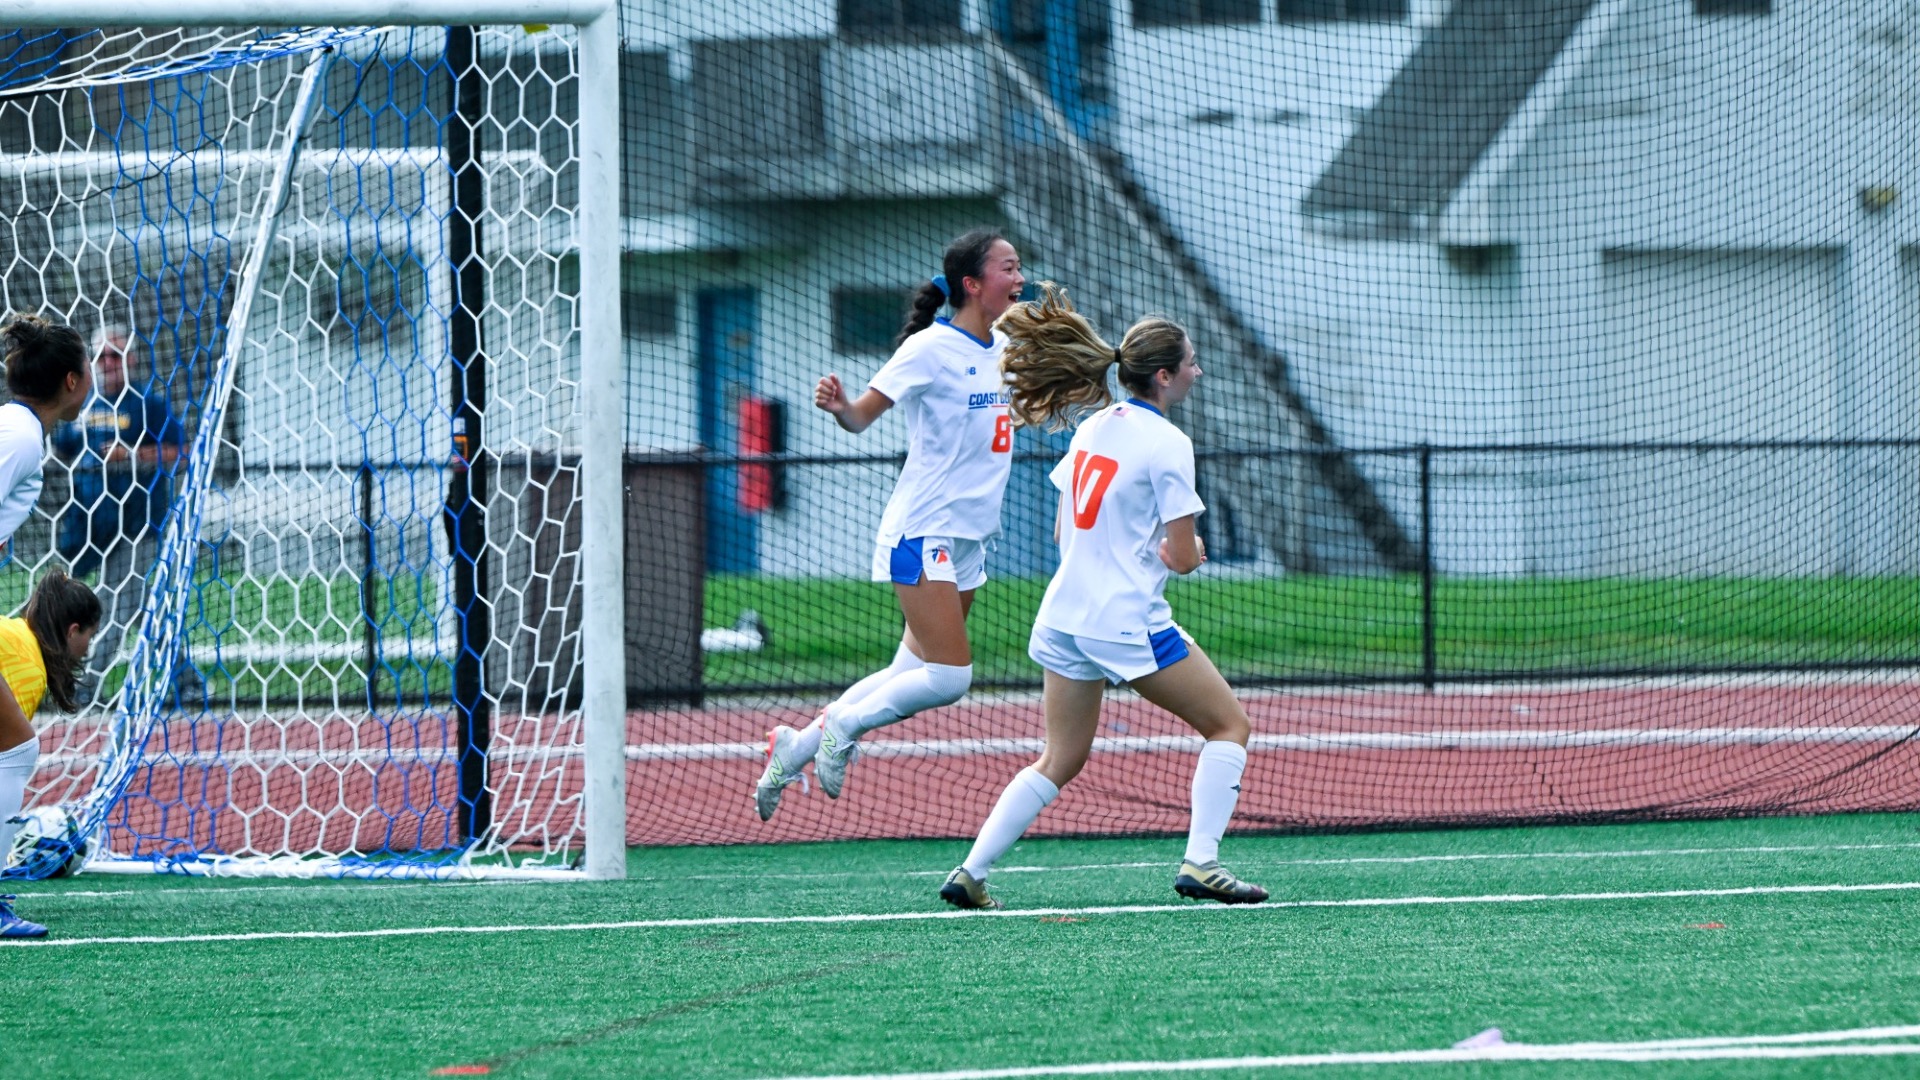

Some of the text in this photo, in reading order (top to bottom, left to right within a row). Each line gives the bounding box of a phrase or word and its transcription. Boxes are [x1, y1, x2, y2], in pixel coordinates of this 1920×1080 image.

[968, 392, 998, 406] COAST
[991, 415, 1011, 453] 8
[1072, 450, 1119, 530] 10
